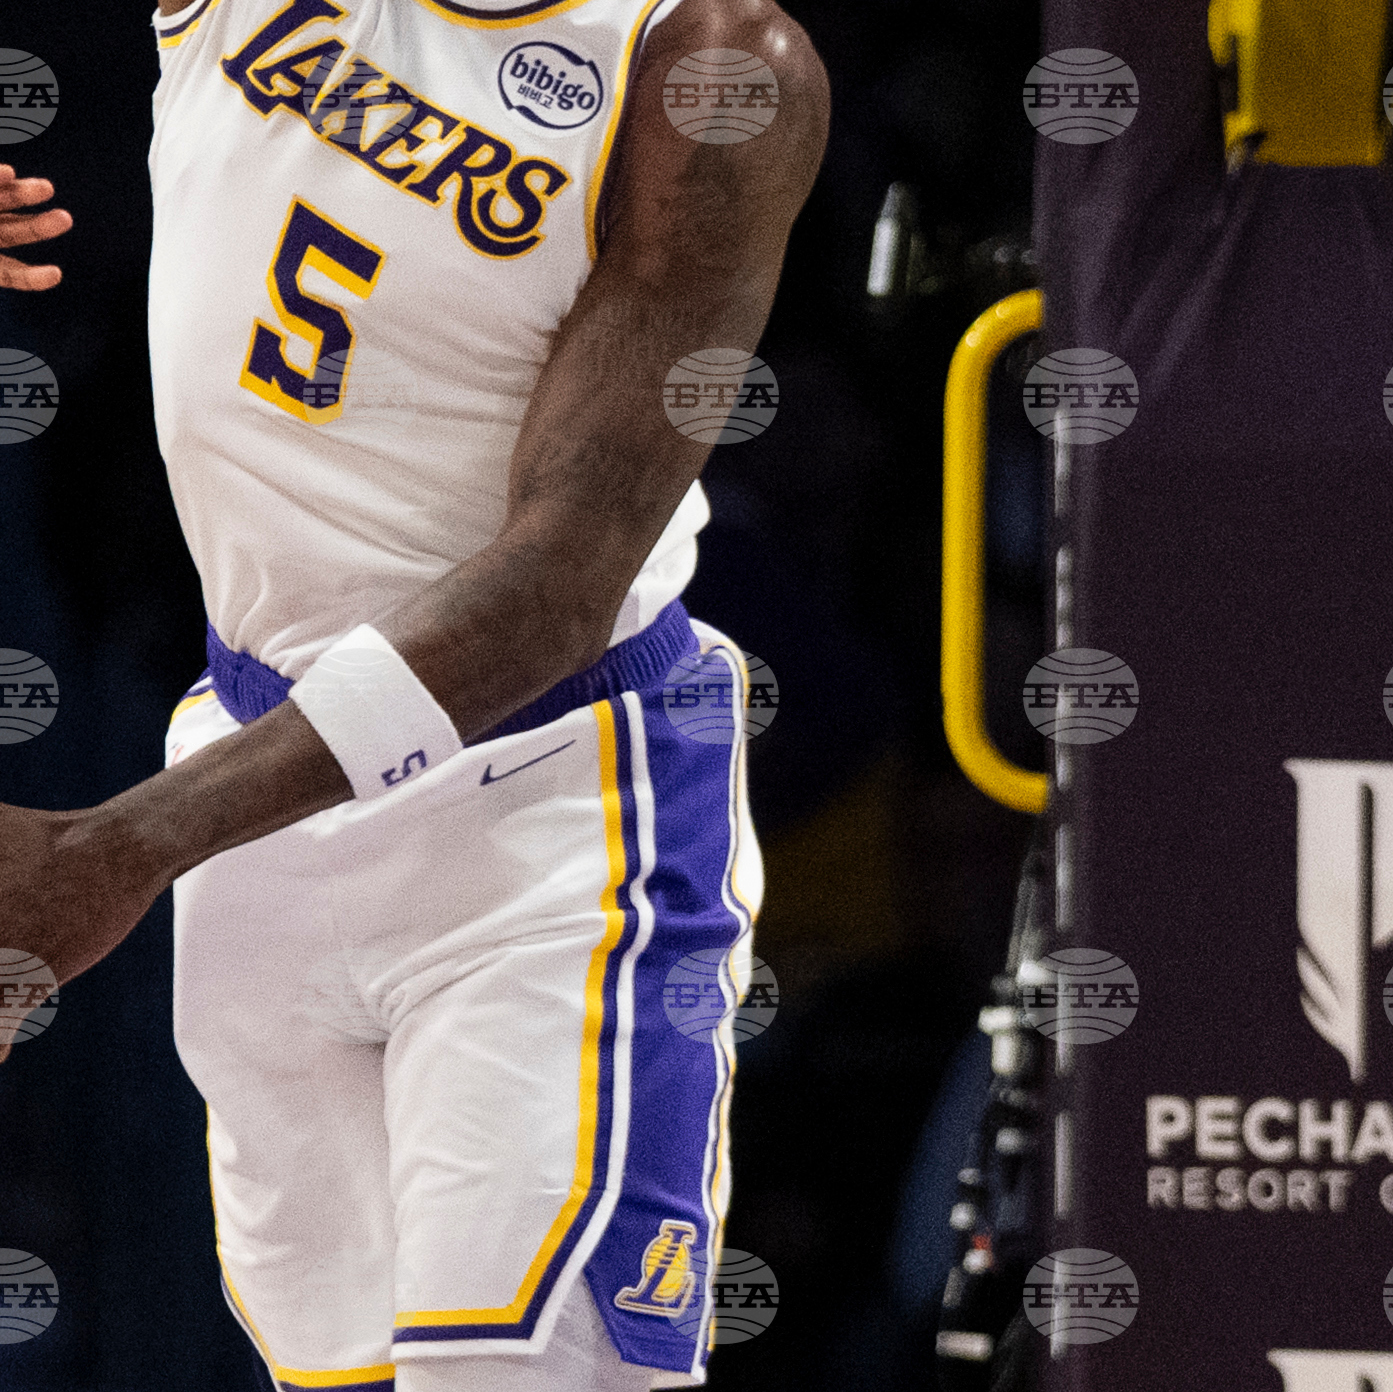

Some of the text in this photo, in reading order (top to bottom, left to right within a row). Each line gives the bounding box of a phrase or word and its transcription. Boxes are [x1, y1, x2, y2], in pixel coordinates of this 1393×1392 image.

[509, 53, 596, 111] bibigo
[239, 194, 387, 425] 5
[1146, 1165, 1354, 1214] RESORT
